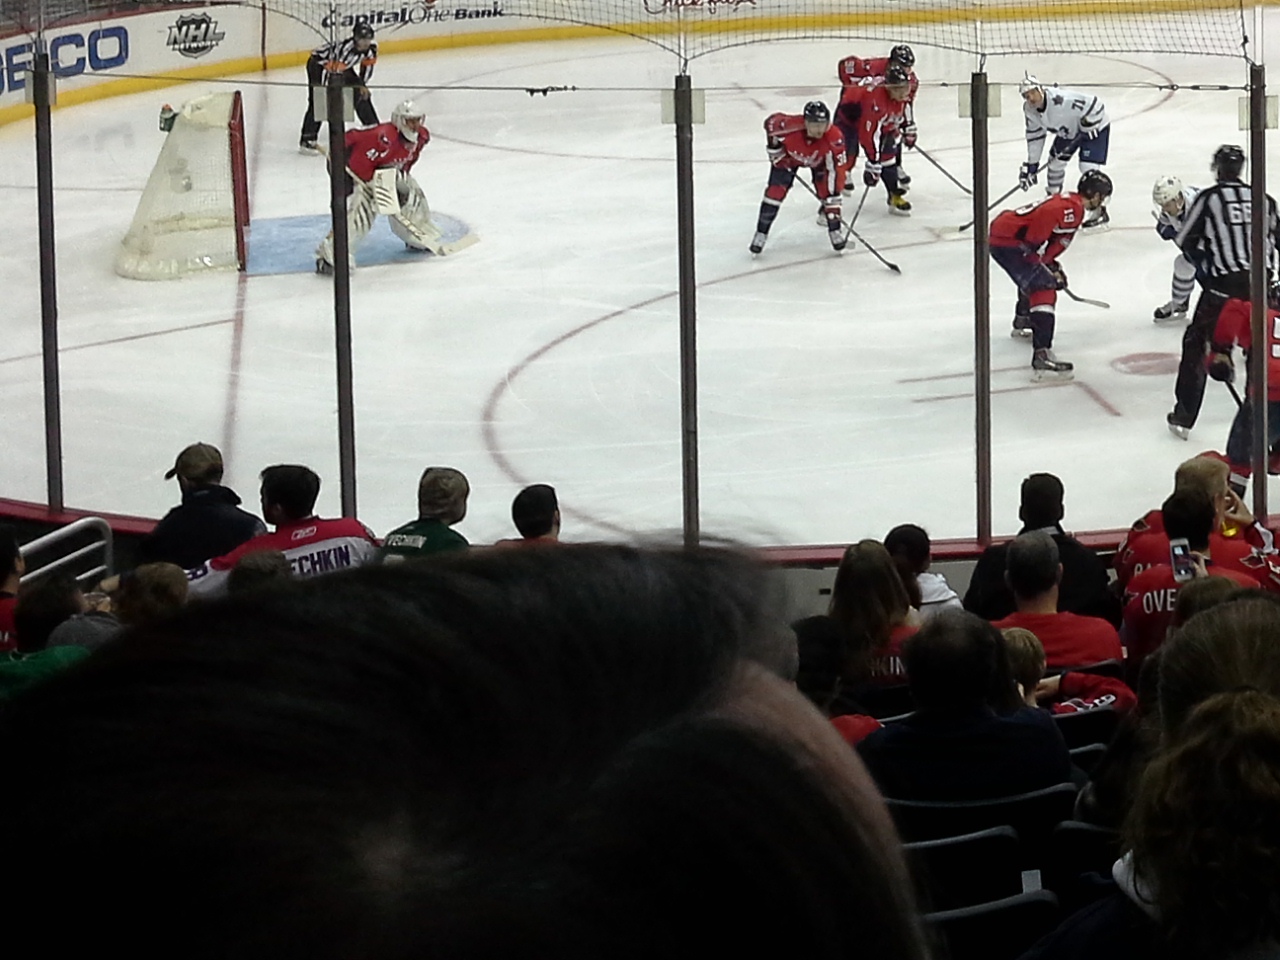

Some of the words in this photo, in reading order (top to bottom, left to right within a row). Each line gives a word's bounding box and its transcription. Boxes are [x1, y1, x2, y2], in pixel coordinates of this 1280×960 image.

[454, 1, 505, 20] Bank
[166, 21, 226, 46] NHL
[0, 26, 129, 95] ECO
